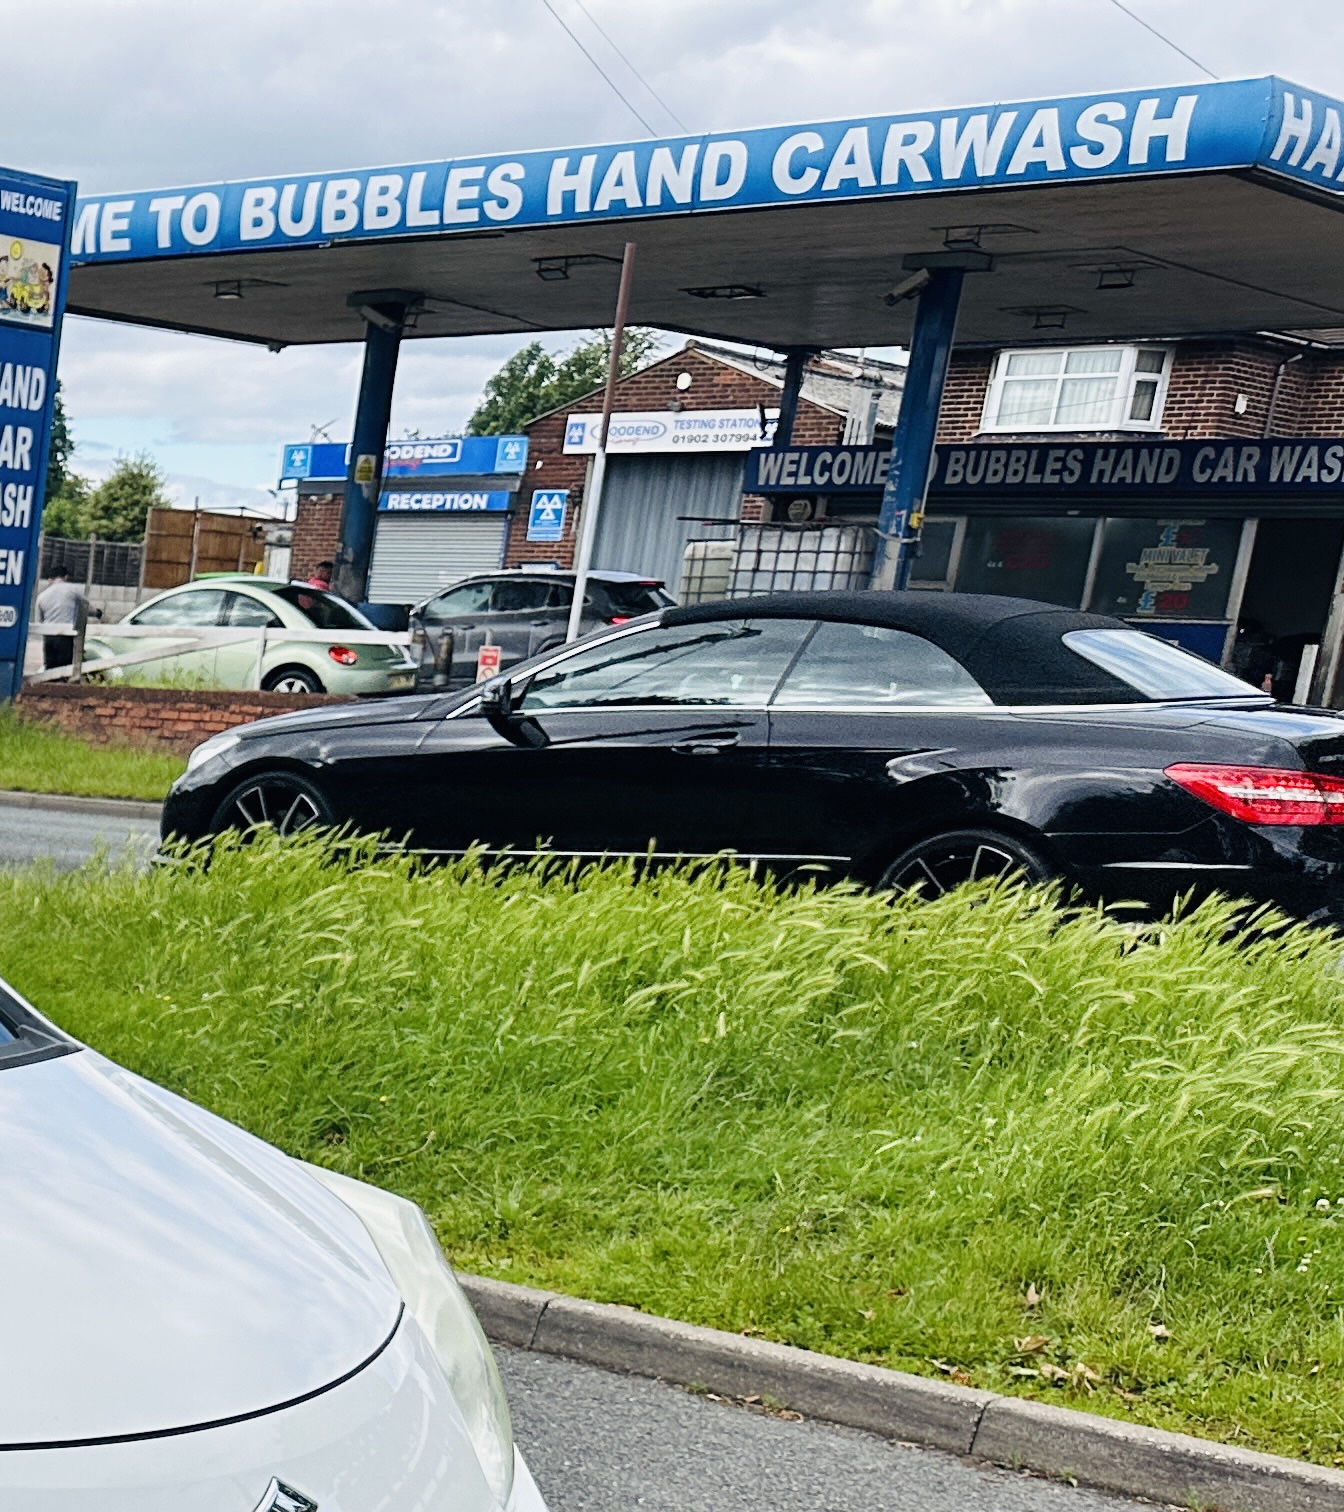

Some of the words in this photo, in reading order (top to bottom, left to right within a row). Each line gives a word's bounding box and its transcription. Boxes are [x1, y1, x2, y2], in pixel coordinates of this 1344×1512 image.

[1270, 92, 1344, 181] HA
[149, 192, 220, 248] TO
[240, 162, 525, 241] BUBBLES
[547, 140, 749, 215] HAND
[772, 94, 1199, 195] CARWASH
[0, 190, 63, 221] WELCOME
[672, 434, 709, 443] 01902
[674, 418, 716, 430] TESTING
[718, 418, 762, 429] STATION
[944, 448, 1084, 484] BUBBLES
[1090, 448, 1181, 484] HAND
[1192, 446, 1261, 483] CAR
[1269, 445, 1344, 483] WAS
[387, 493, 488, 509] RECEPTION
